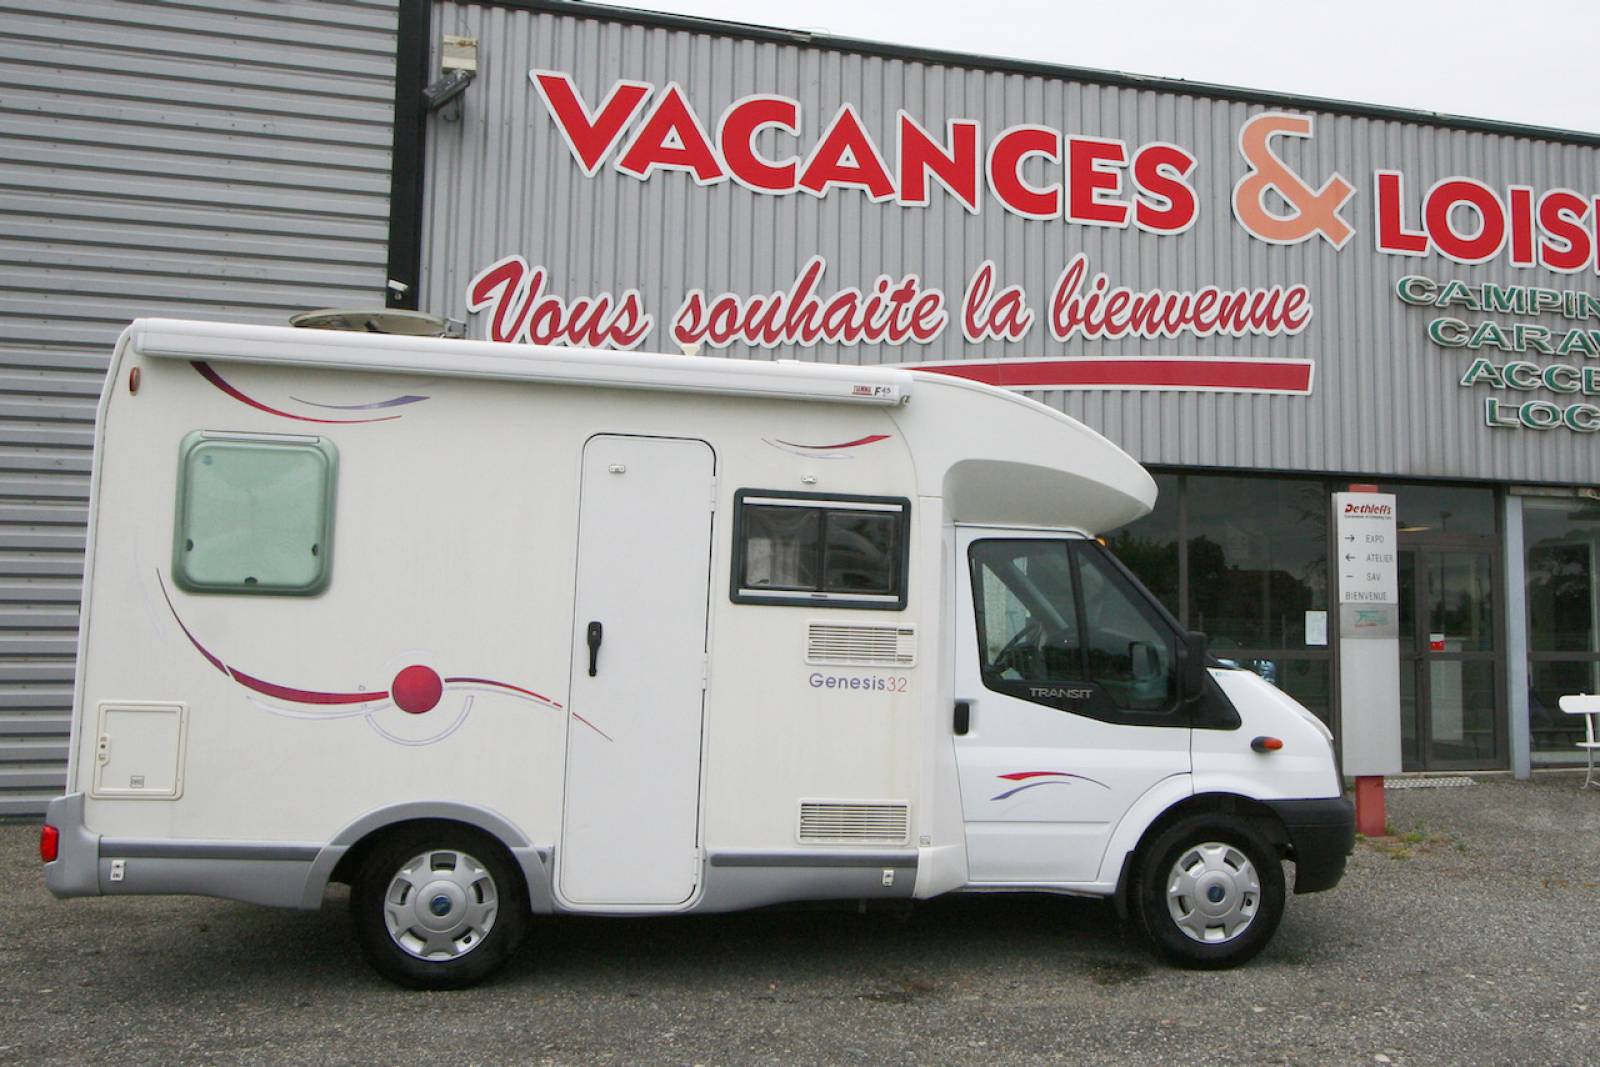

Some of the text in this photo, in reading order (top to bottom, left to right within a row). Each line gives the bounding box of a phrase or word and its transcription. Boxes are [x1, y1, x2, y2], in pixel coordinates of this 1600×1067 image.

[529, 69, 1600, 275] VACANCES & LOIS
[466, 252, 1314, 350] Vous souhaite la bienvenue
[1428, 317, 1600, 358] CARA
[1344, 503, 1392, 515] Dethleffs
[1365, 534, 1385, 544] EXPO
[1366, 553, 1393, 563] ATELIER
[1366, 572, 1382, 582] SAV
[1345, 591, 1387, 601] BIENVENUE
[1028, 686, 1093, 699] TRANSIT
